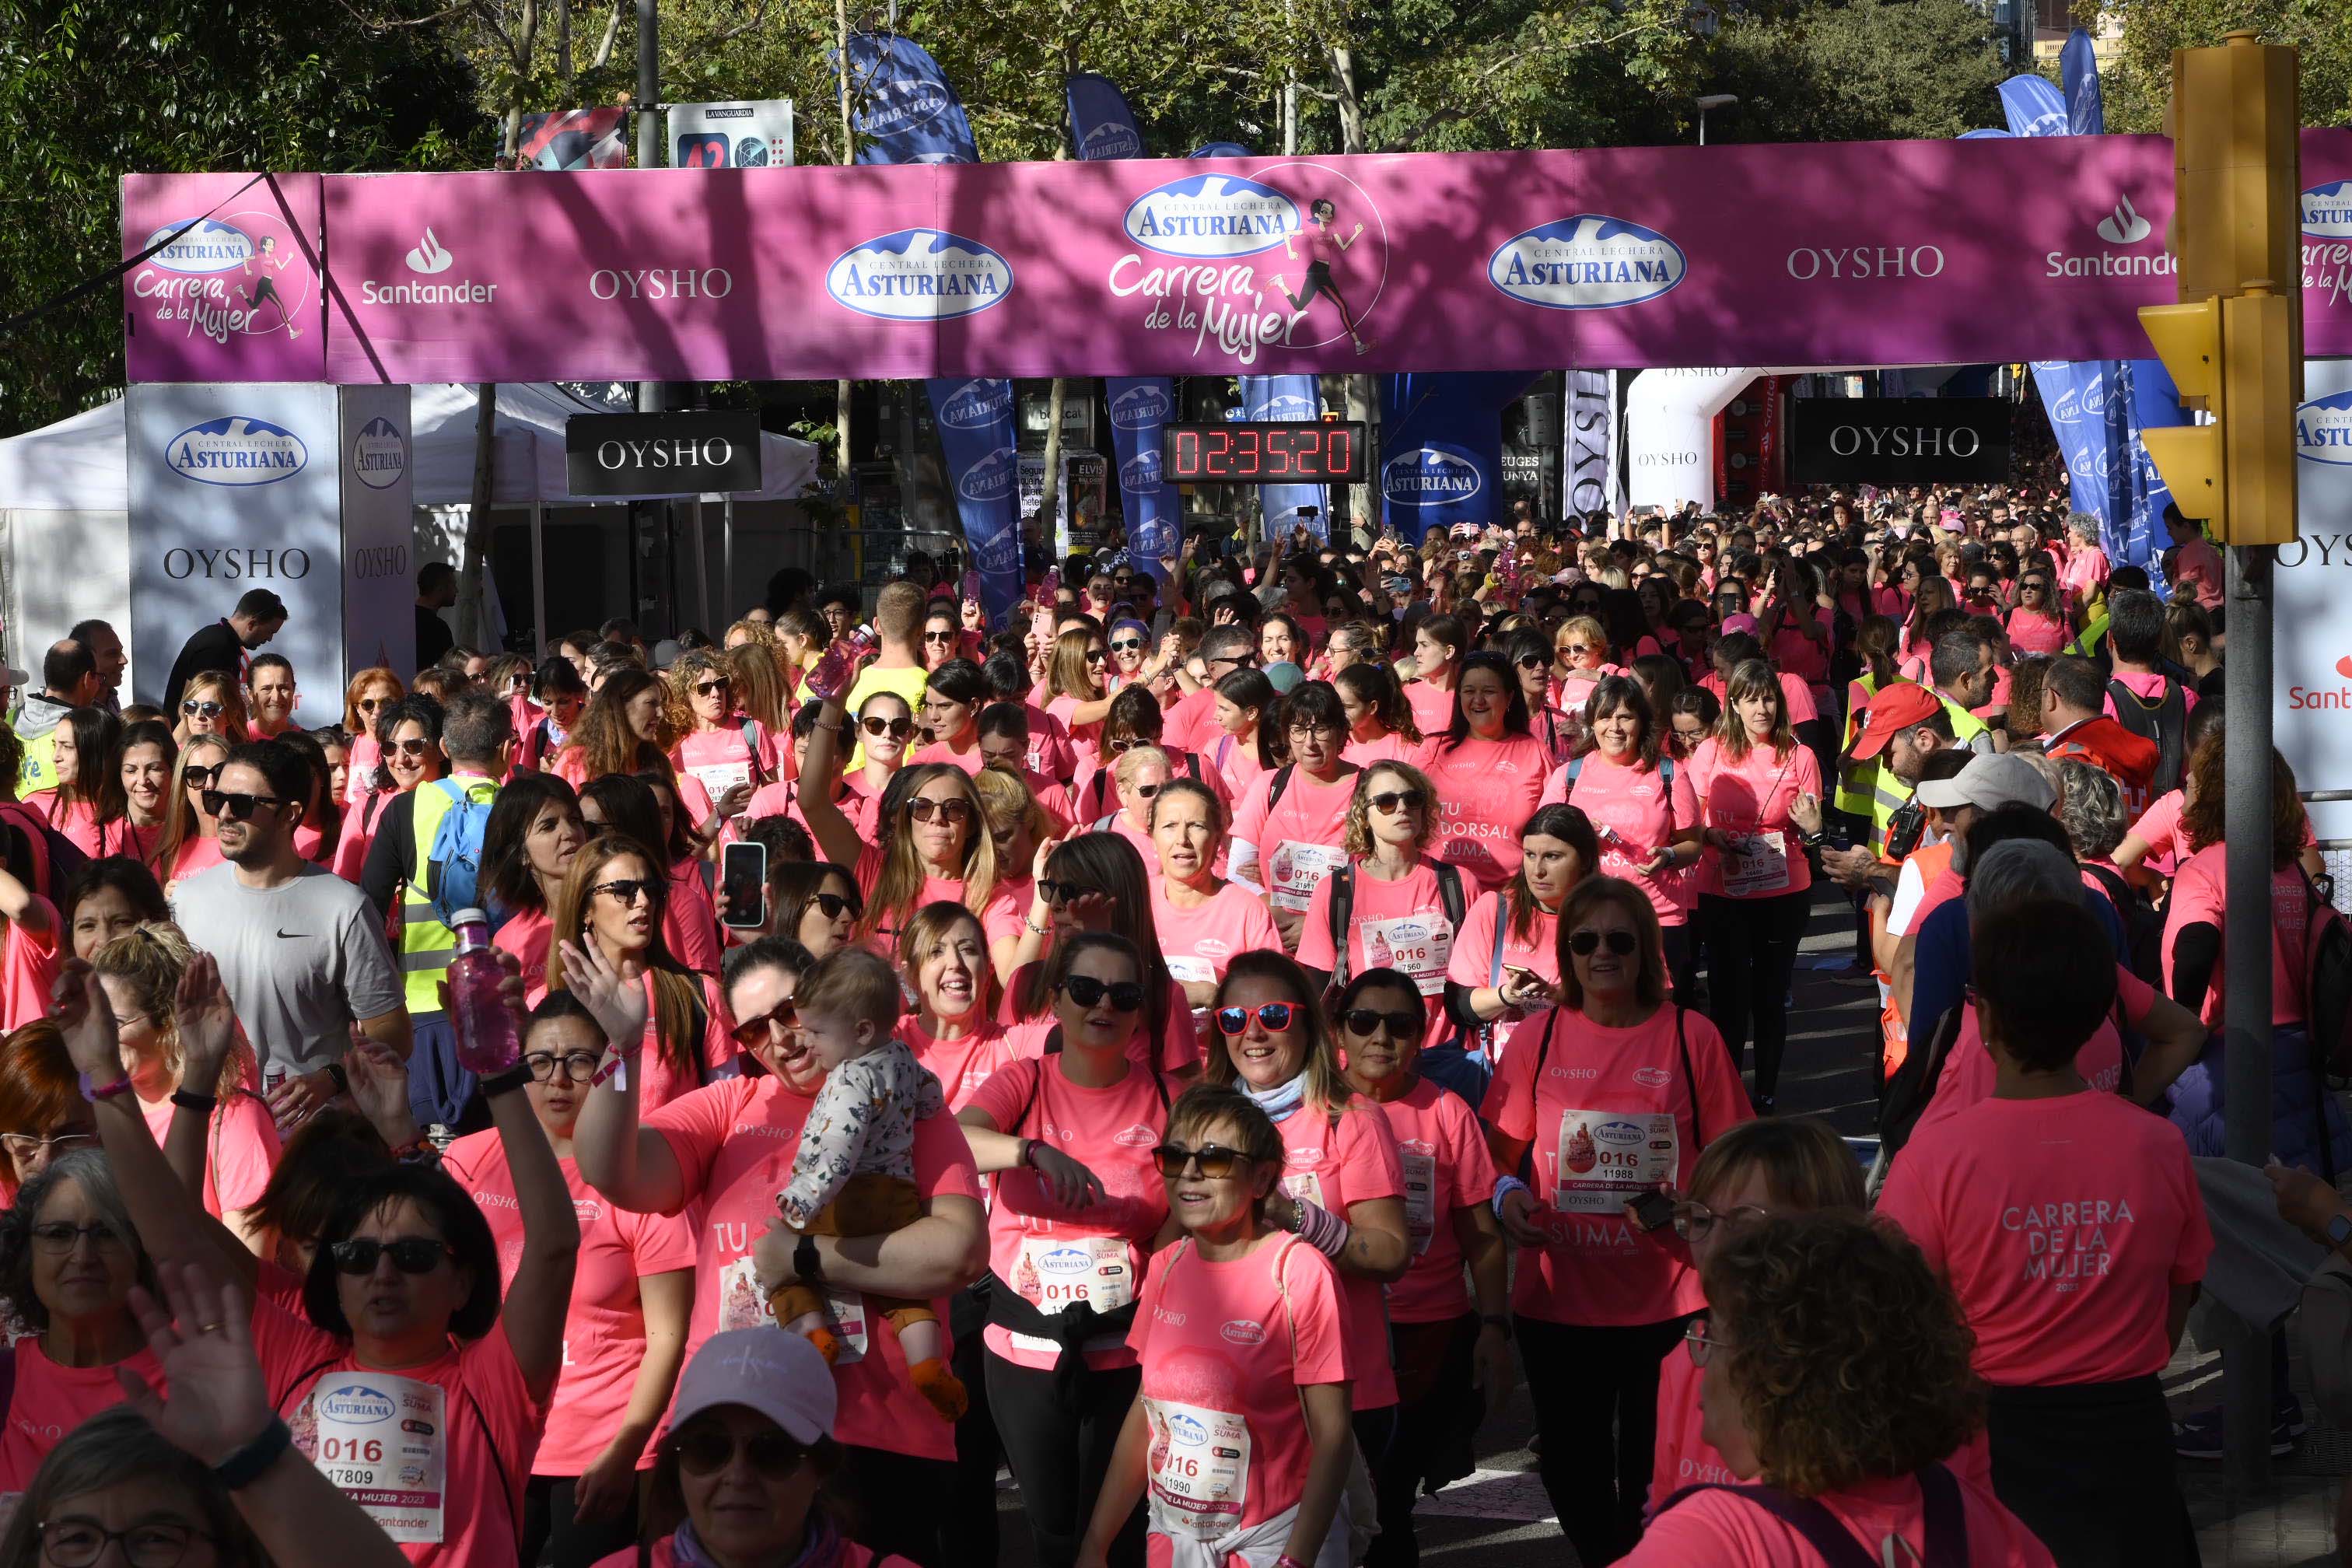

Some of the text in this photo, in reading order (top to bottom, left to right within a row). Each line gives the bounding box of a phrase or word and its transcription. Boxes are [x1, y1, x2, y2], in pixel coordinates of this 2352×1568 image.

[715, 108, 754, 117] VANGUARDIA
[1164, 201, 1283, 212] CENTRAL LECHERA
[1136, 205, 1286, 236] ASTURIANA
[1534, 246, 1664, 258] CENTRAL LECHERA
[1786, 244, 1944, 279] OYSHO
[870, 259, 992, 270] CENTRAL LECHERA
[1503, 250, 1671, 286] ASTURIANA
[134, 269, 226, 299] Carrera
[589, 267, 733, 299] OYSHO
[841, 263, 999, 296] ASTURIANA
[1108, 253, 1255, 298] Carrera
[2318, 265, 2333, 289] la
[362, 279, 497, 305] Santander
[156, 296, 260, 344] de la Mujer
[1144, 291, 1310, 365] de la Mujer
[1829, 425, 1980, 457] OYSHO
[177, 441, 298, 469] ASTURIANA
[356, 442, 403, 472] ASTURIANA
[597, 436, 733, 470] OYSHO
[1177, 431, 1350, 474] 02:35:20
[1638, 451, 1698, 467] OYSHO
[1079, 464, 1103, 474] ELVIS
[1385, 471, 1474, 493] ASTURIANA
[163, 548, 311, 579] OYSHO
[354, 544, 407, 580] OYSHO
[1440, 821, 1509, 839] DORSAL
[1442, 841, 1489, 856] SUMA
[1294, 870, 1320, 881] 016
[1395, 947, 1426, 961] 016
[1551, 1066, 1597, 1080] OYSHO
[1635, 1073, 1670, 1083] ASTURIANA
[734, 1122, 794, 1140] OYSHO
[1118, 1131, 1158, 1143] ASTURIANA
[1598, 1130, 1642, 1141] ASTURIANA
[1599, 1151, 1639, 1167] 016
[1603, 1169, 1633, 1179] 11988
[1569, 1196, 1605, 1206] OYSHO
[2003, 1199, 2135, 1231] CARRERA
[712, 1222, 747, 1252] TU
[1551, 1223, 1634, 1247] SUMA
[2028, 1227, 2109, 1256] DE LA
[1042, 1259, 1090, 1269] ASTURIANA
[2024, 1252, 2112, 1282] MUJER
[1046, 1283, 1089, 1300] 016
[324, 1402, 389, 1416] ASTURIANA
[1213, 1429, 1241, 1440] SUMA
[323, 1437, 383, 1462] 016
[327, 1469, 374, 1485] 17809
[360, 1493, 397, 1503] MUJER
[401, 1495, 425, 1504] 2023
[1182, 1501, 1208, 1511] MUJER
